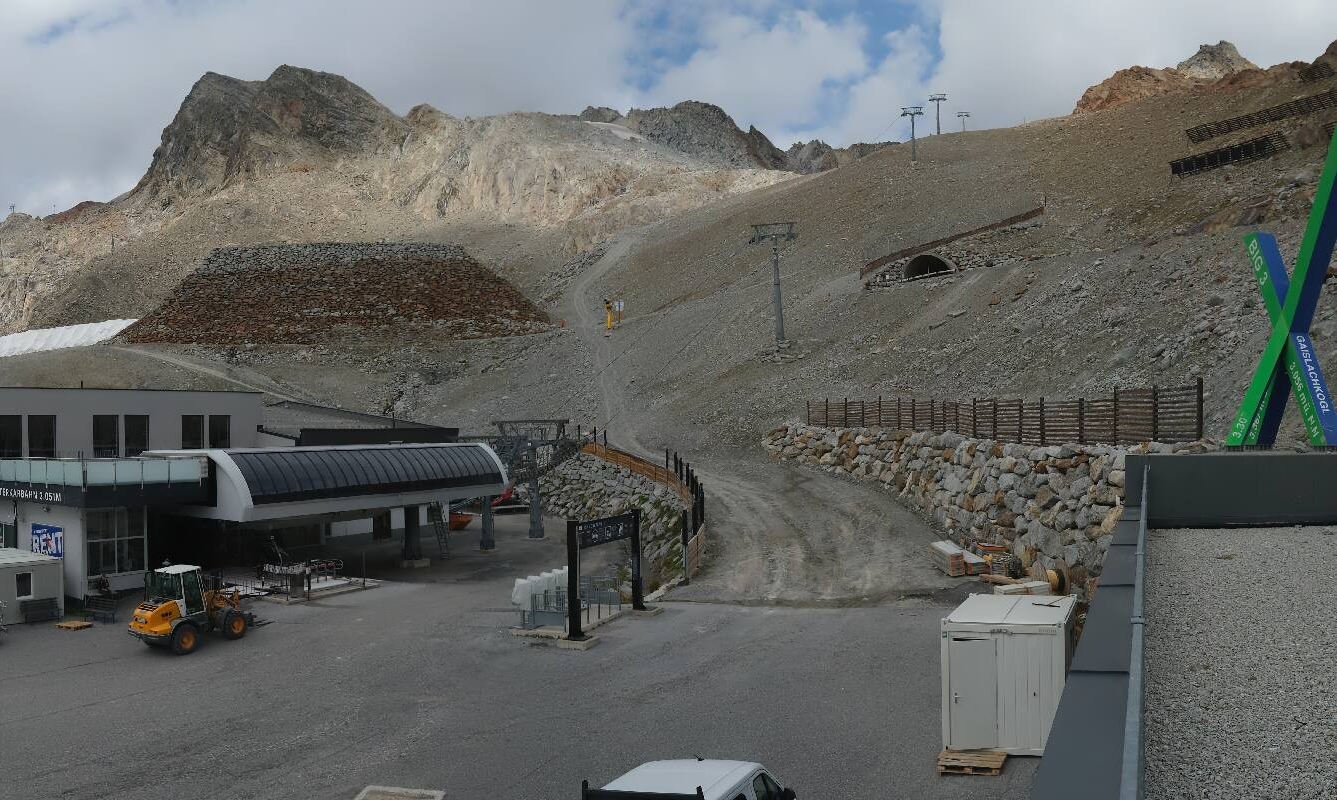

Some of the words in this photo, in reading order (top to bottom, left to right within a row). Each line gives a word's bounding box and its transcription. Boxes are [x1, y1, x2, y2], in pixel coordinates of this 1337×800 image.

[1248, 238, 1264, 272] BIG
[1259, 271, 1268, 286] 3
[1296, 335, 1331, 414] GAISLACHKOGL
[32, 532, 63, 554] RENT
